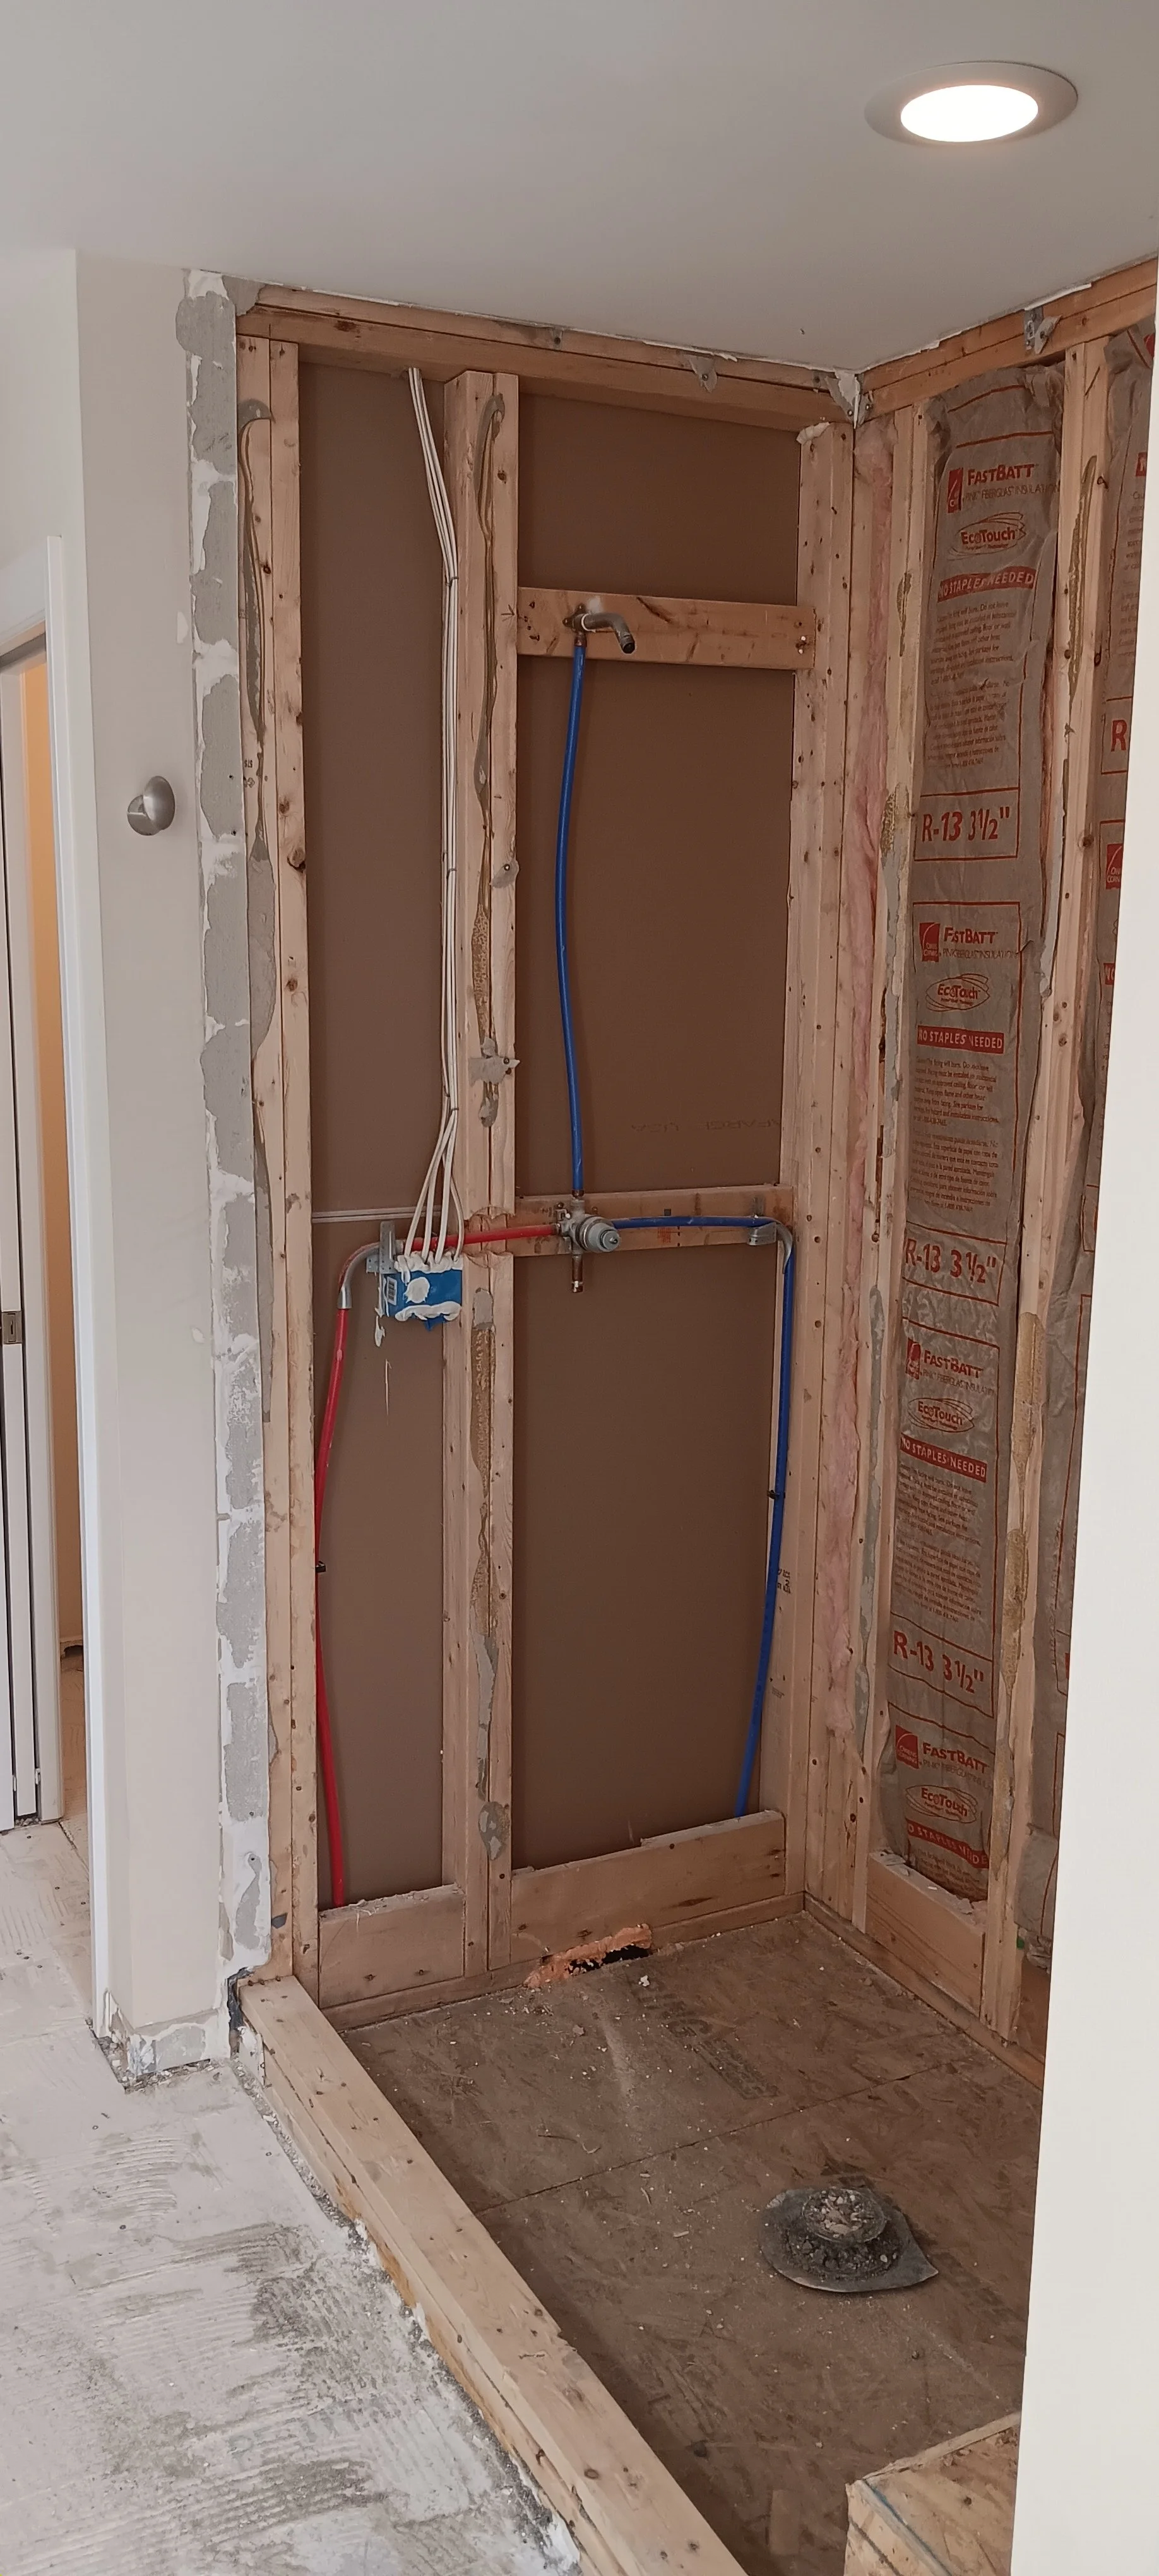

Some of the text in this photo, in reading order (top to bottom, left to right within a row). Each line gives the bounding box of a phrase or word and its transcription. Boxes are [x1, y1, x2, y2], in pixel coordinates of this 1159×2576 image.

[922, 811, 963, 842] R-13
[929, 1030, 967, 1045] STAPLES
[905, 1237, 941, 1273] R-13
[917, 1400, 963, 1426] EcoTouch
[912, 1442, 947, 1465] STAPLES
[949, 1456, 986, 1478] NEEDED
[893, 1630, 934, 1672] R-13
